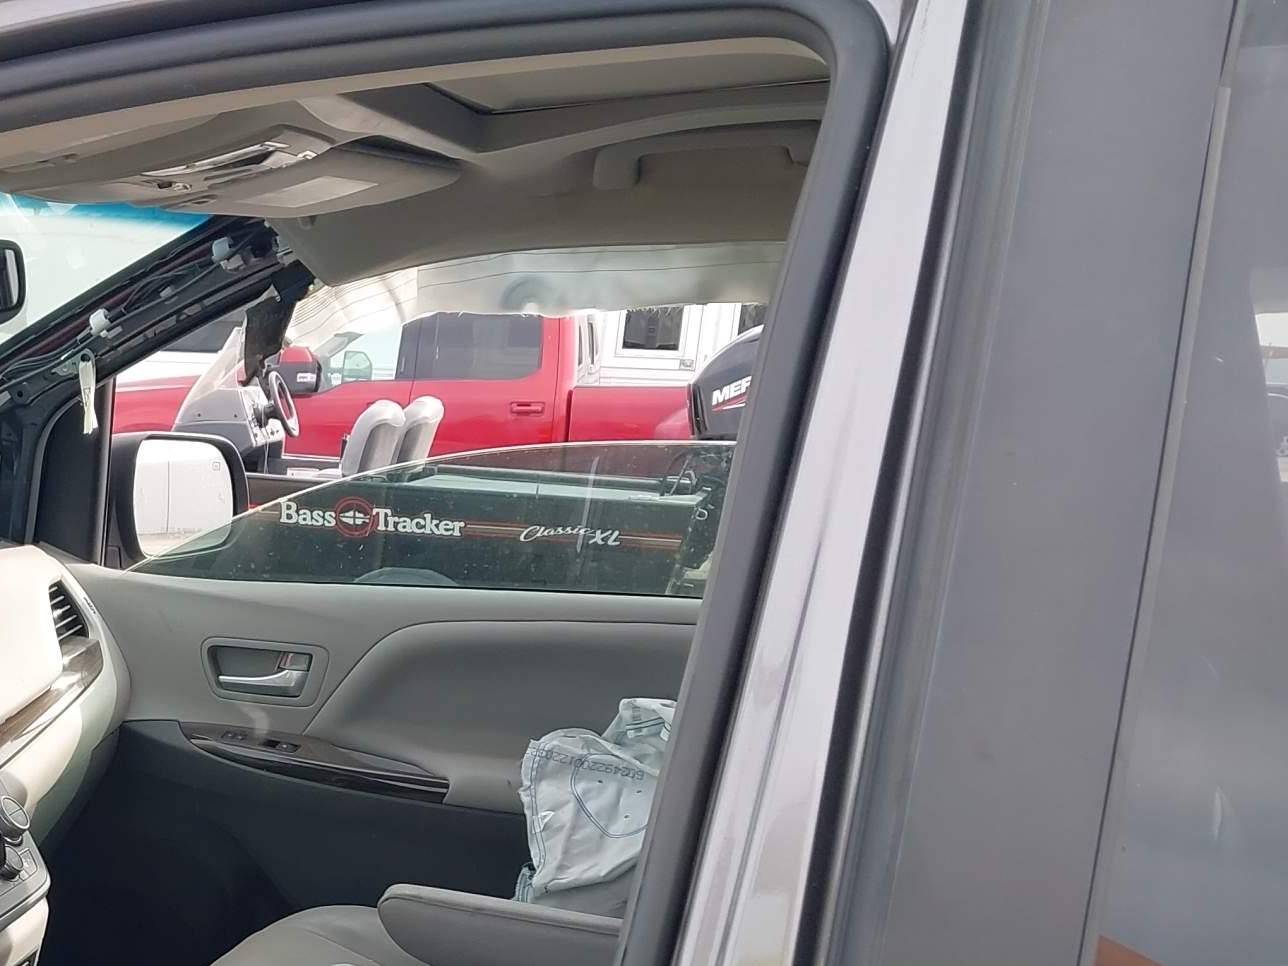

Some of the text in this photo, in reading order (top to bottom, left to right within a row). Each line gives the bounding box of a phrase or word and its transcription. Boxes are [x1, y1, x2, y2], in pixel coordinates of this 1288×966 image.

[279, 500, 465, 536] Bass Tracker
[519, 525, 620, 546] Classic XL
